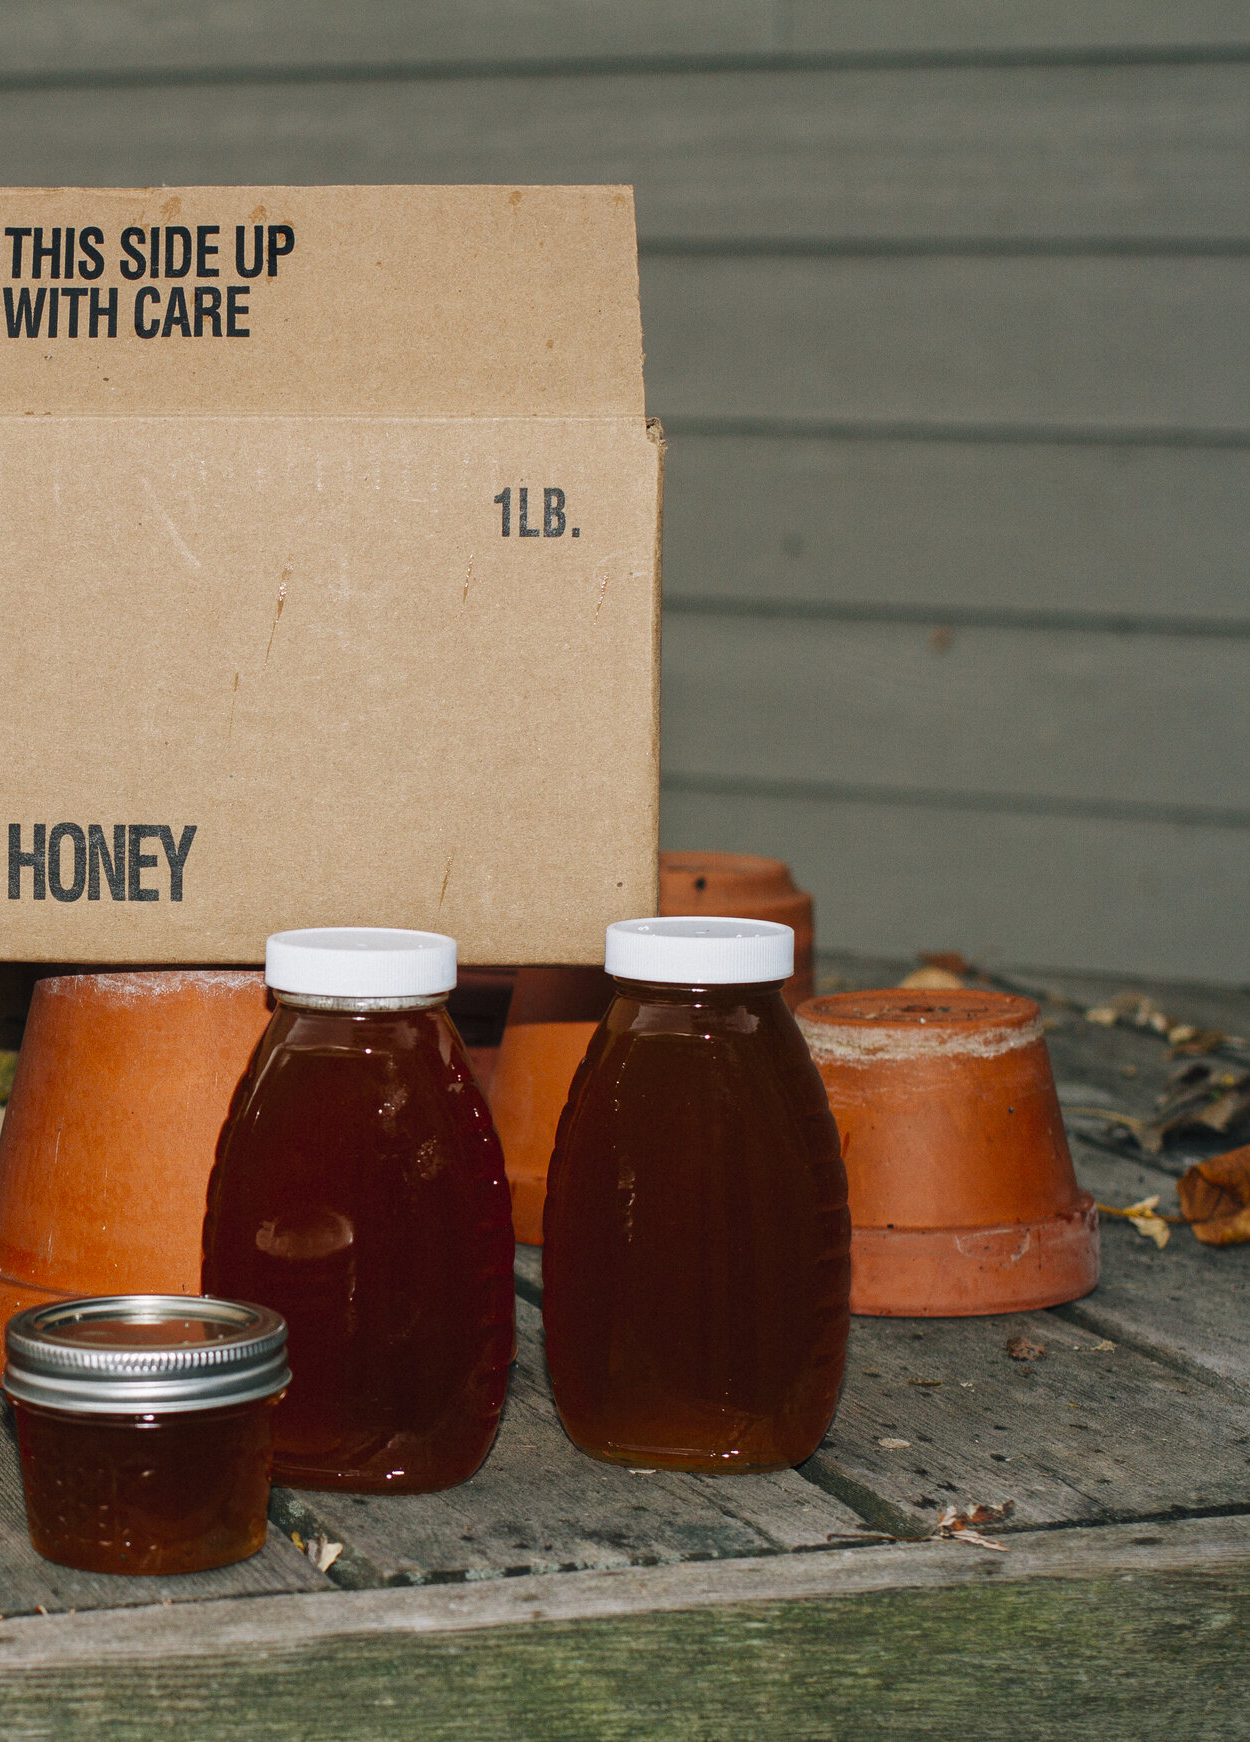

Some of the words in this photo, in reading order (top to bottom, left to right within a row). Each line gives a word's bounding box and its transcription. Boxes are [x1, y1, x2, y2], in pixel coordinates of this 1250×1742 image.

[4, 226, 105, 281] THIS
[119, 225, 220, 281] SIDE
[235, 224, 295, 279] UP
[2, 286, 119, 339] WITH
[134, 285, 251, 339] CARE
[8, 822, 198, 903] HONEY
